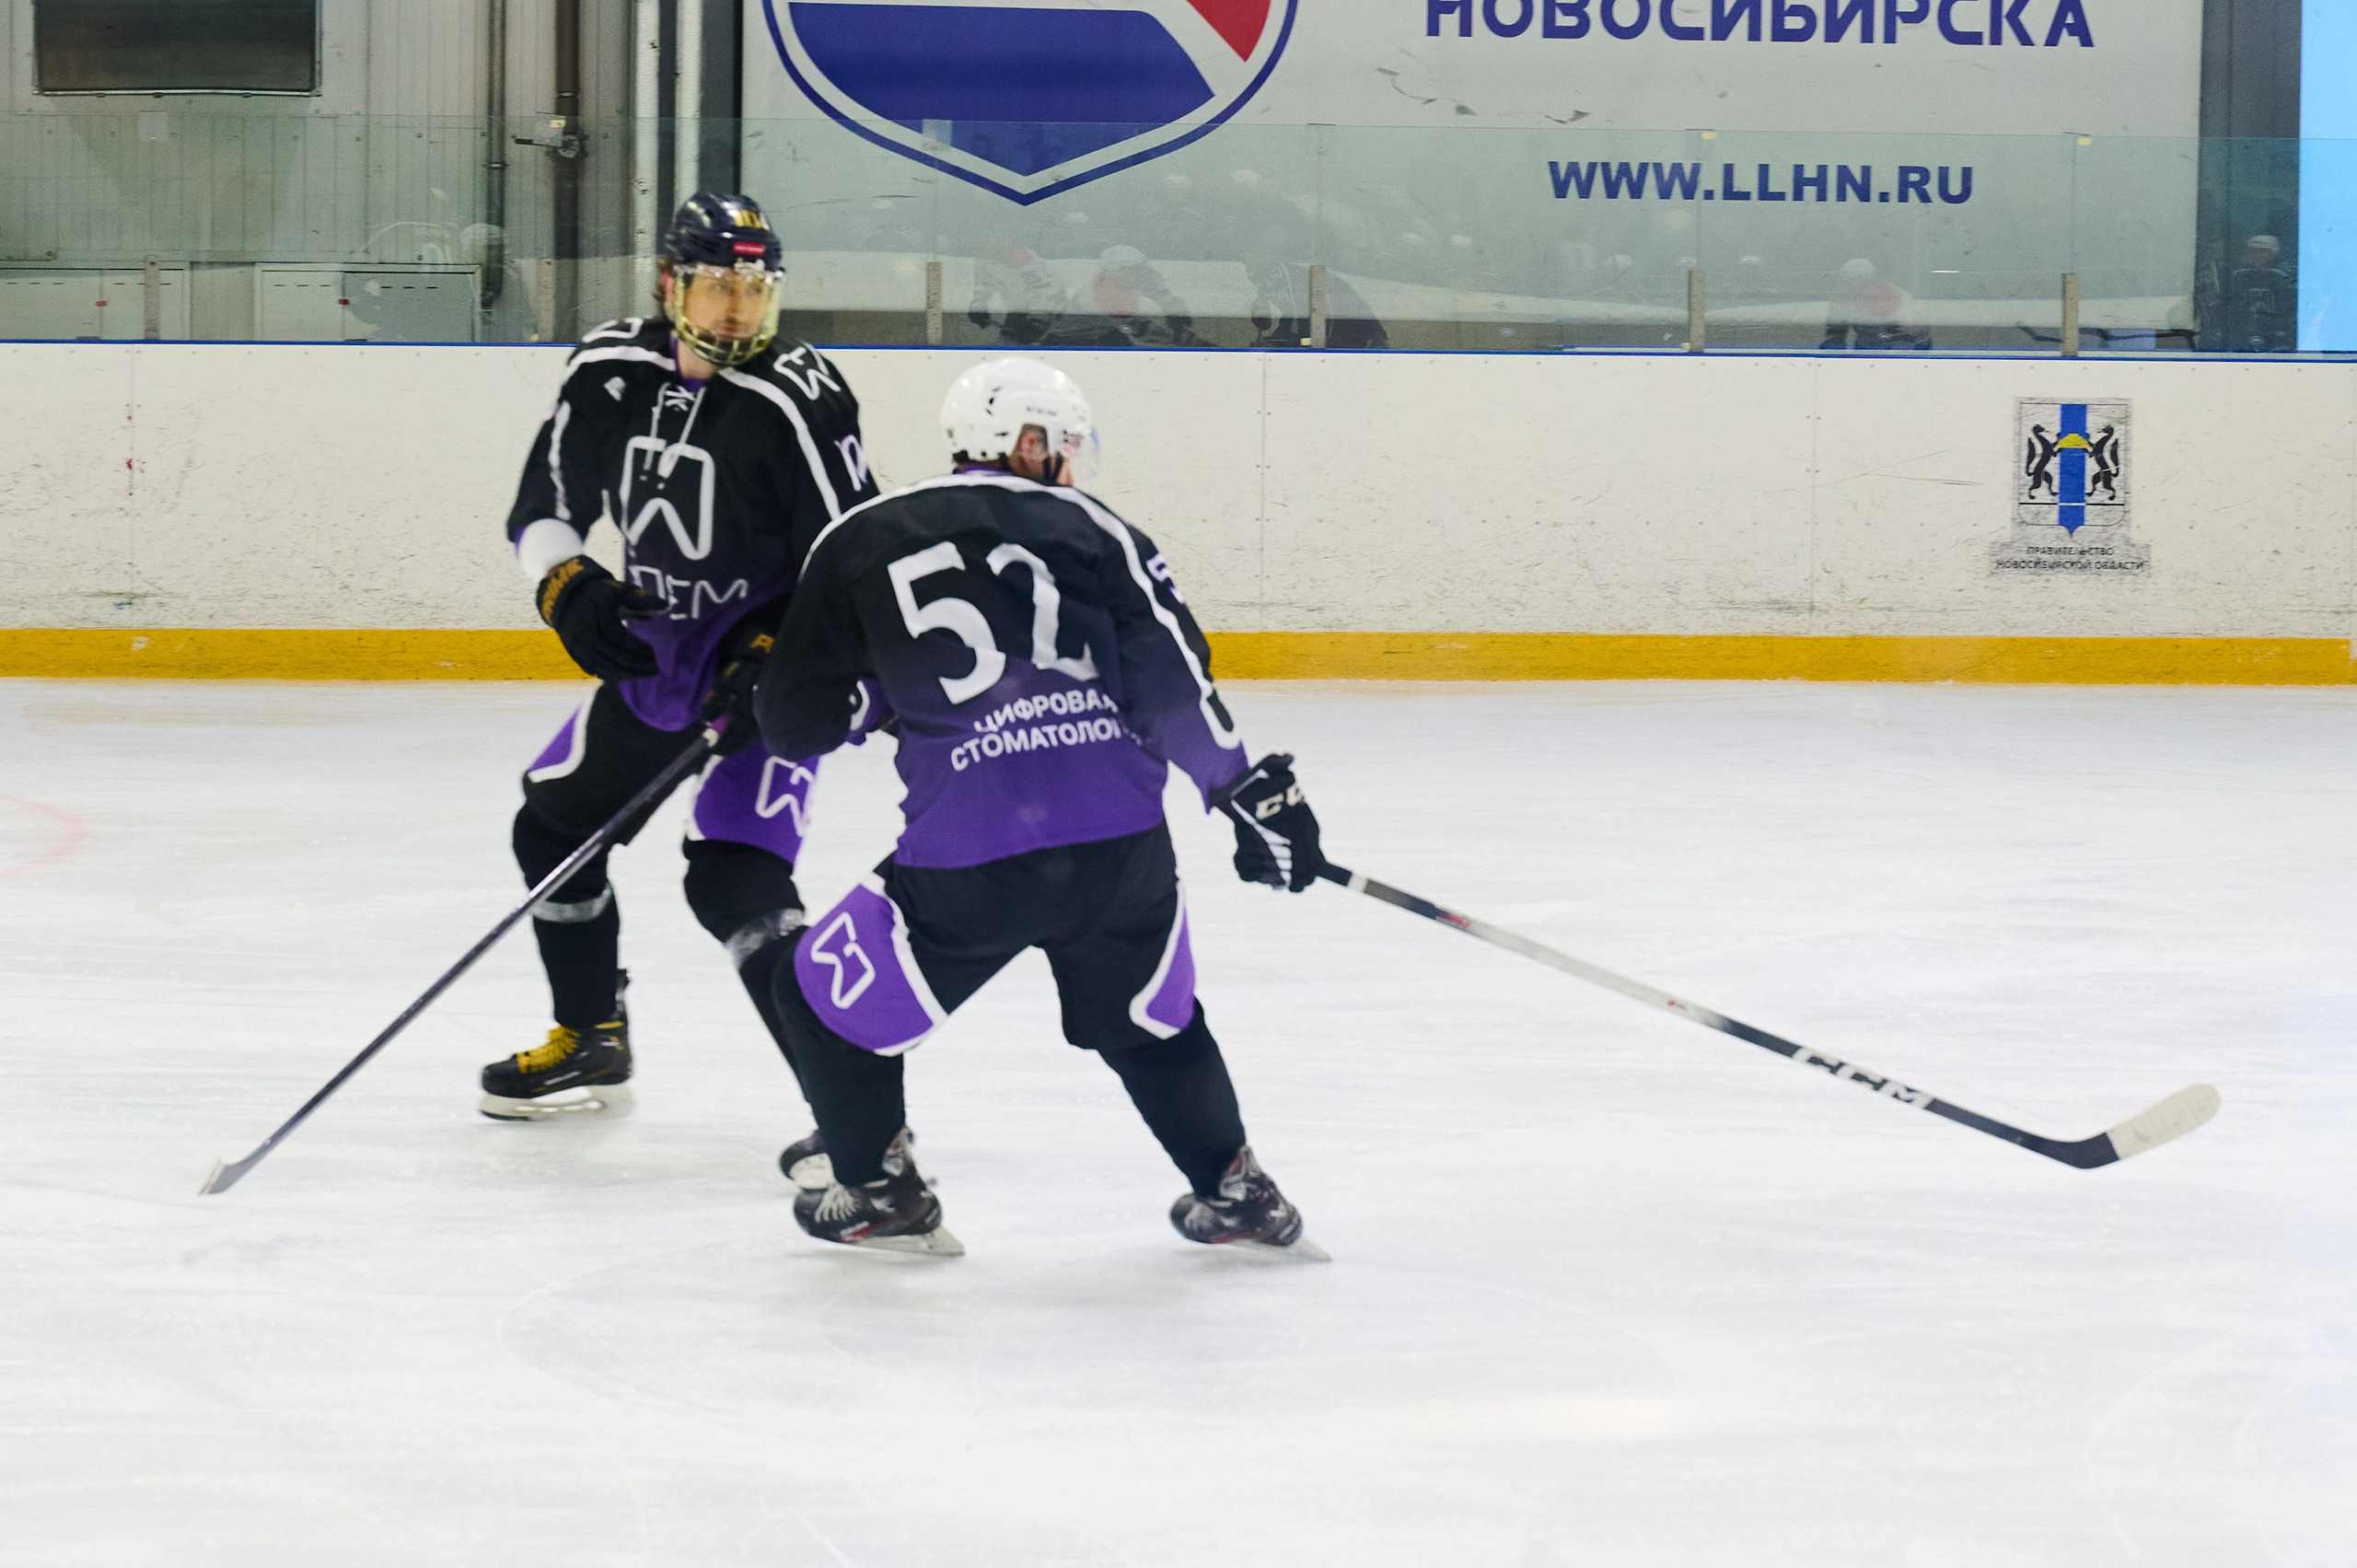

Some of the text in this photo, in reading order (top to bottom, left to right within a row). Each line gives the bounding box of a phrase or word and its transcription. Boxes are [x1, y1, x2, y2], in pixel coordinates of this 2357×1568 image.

[1425, 0, 2096, 47] НОВОСИБИРСКА
[1548, 160, 1973, 204] WWW.LLHN.RU
[2026, 546, 2114, 556] ПРАВИТЕЬСТВО
[887, 541, 1099, 705] 52
[951, 717, 1142, 772] СТОМАТОЛО
[1792, 1046, 1934, 1109] CCM
